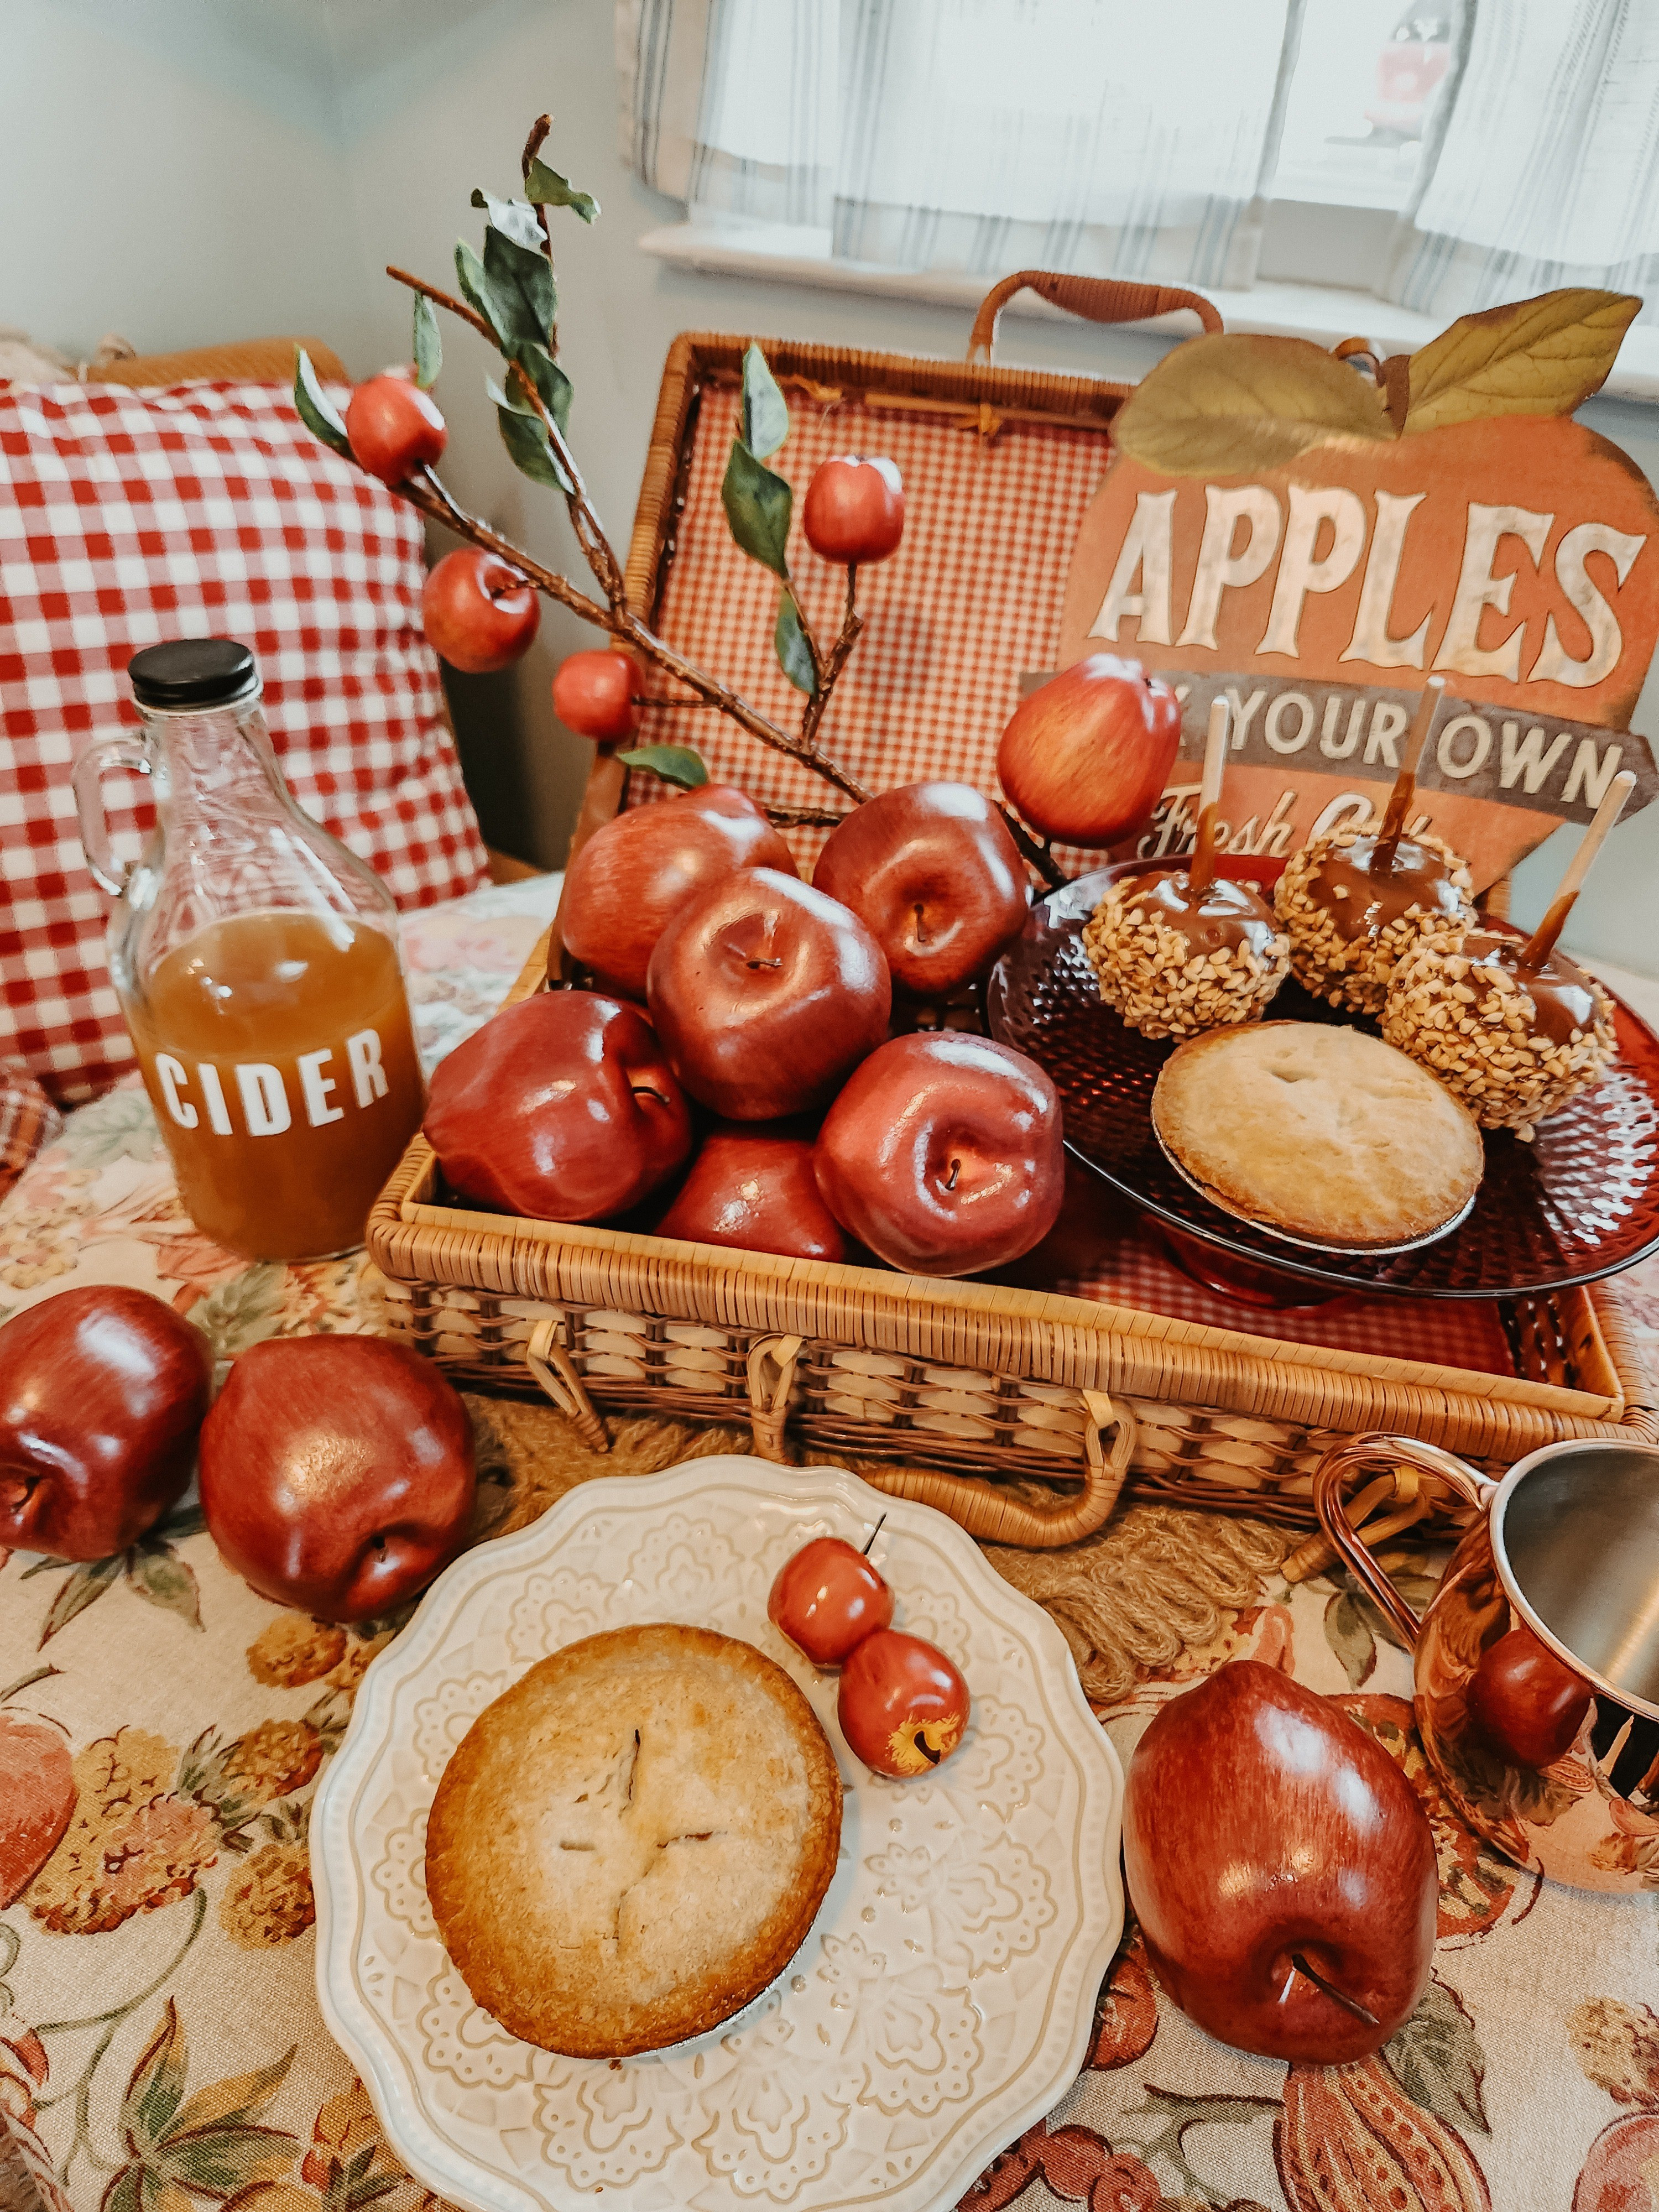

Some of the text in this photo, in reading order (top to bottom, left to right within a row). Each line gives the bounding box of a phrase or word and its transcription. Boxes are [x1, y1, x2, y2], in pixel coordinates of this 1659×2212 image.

[1087, 484, 1646, 688] APPLES
[1224, 688, 1407, 768] YOUR
[1437, 716, 1623, 809] OWN
[155, 1029, 389, 1136] CIDER
